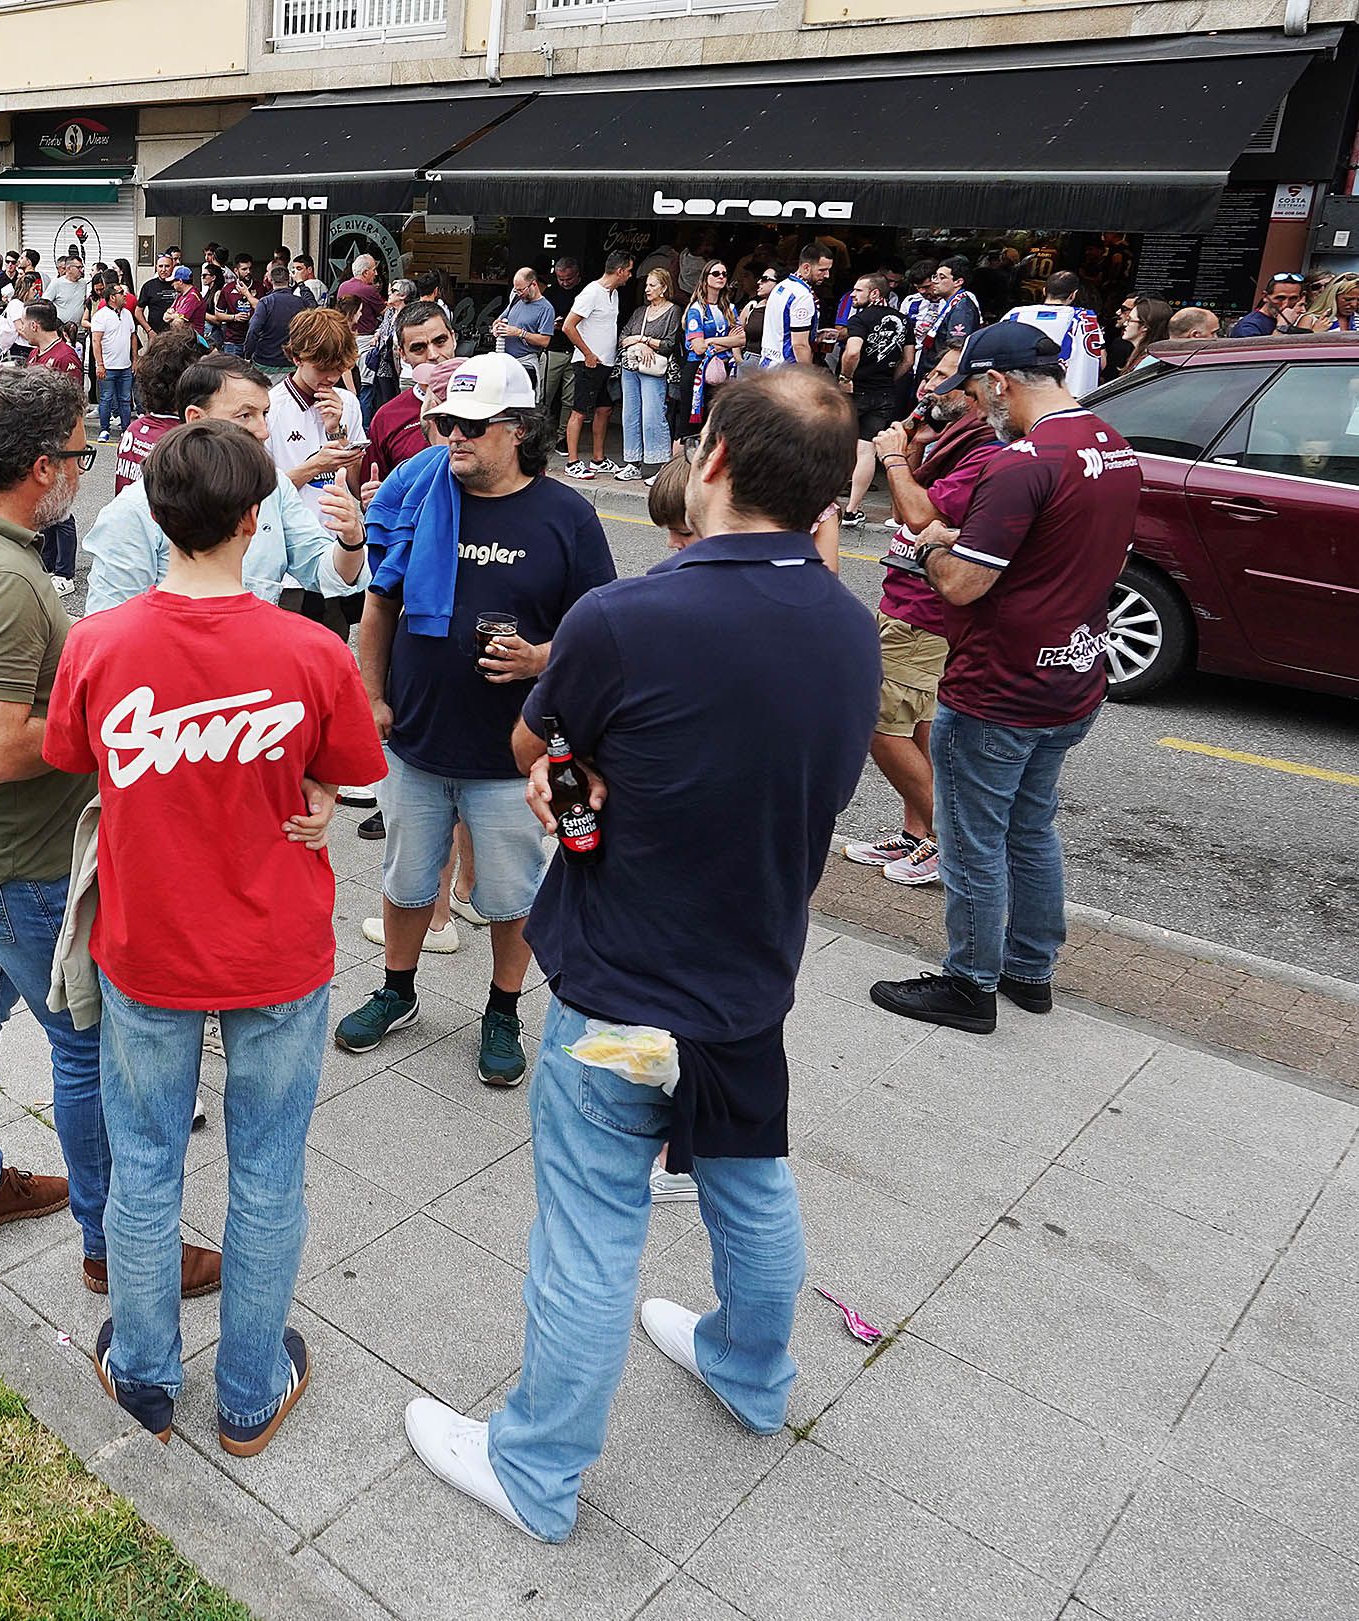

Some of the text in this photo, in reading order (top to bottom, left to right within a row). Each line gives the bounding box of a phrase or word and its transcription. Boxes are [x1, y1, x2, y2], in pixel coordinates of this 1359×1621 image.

[211, 193, 328, 212] borona
[653, 190, 854, 219] borona
[345, 220, 379, 236] RIVERA
